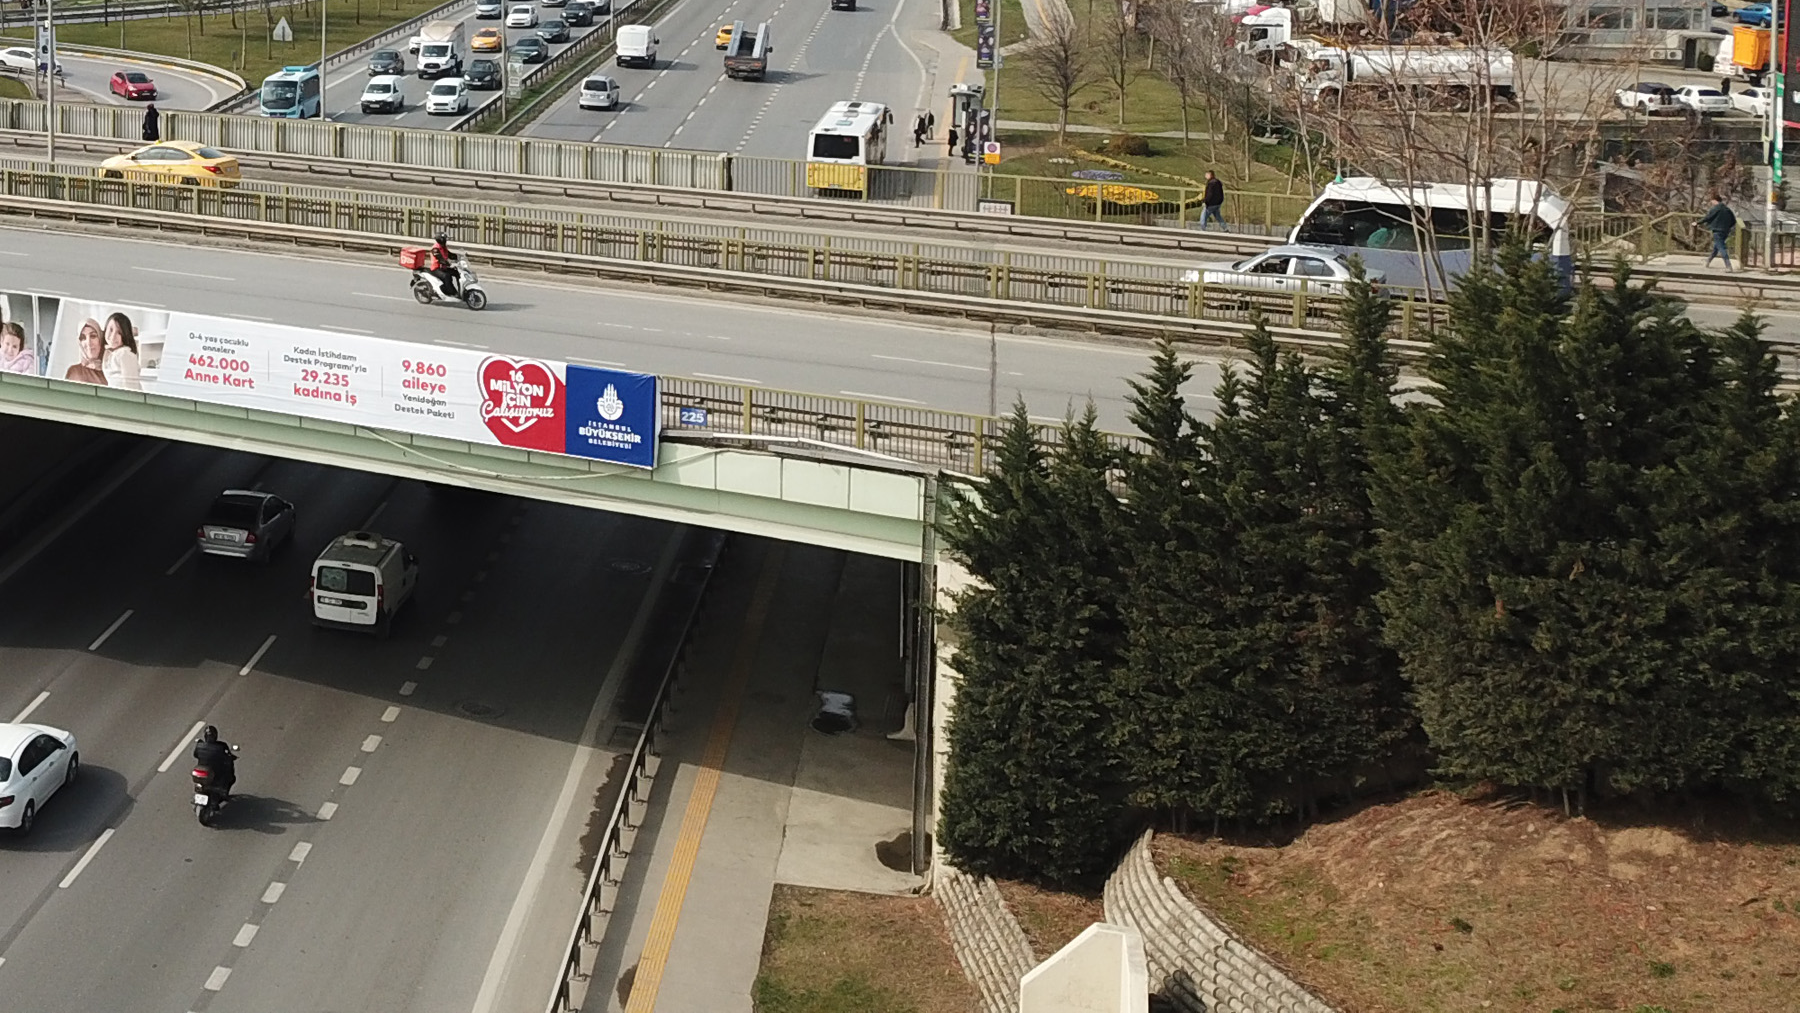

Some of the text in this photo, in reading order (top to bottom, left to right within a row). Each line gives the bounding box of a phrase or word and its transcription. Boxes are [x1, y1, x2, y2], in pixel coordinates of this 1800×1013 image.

[189, 332, 203, 341] 0-4
[219, 338, 249, 347] çocuklu
[202, 345, 236, 355] annelere
[188, 353, 250, 373] 462.000
[283, 354, 368, 374] Destek Programı'yla
[402, 359, 447, 377] 9.860
[184, 368, 255, 389] Anne Kart
[301, 368, 350, 387] 29.235
[402, 376, 447, 395] aileye
[509, 370, 525, 383] 16
[293, 382, 358, 406] kadına iş
[402, 393, 447, 406] Yenidoğan
[394, 403, 455, 419] Destek Paketi
[681, 411, 705, 424] 225
